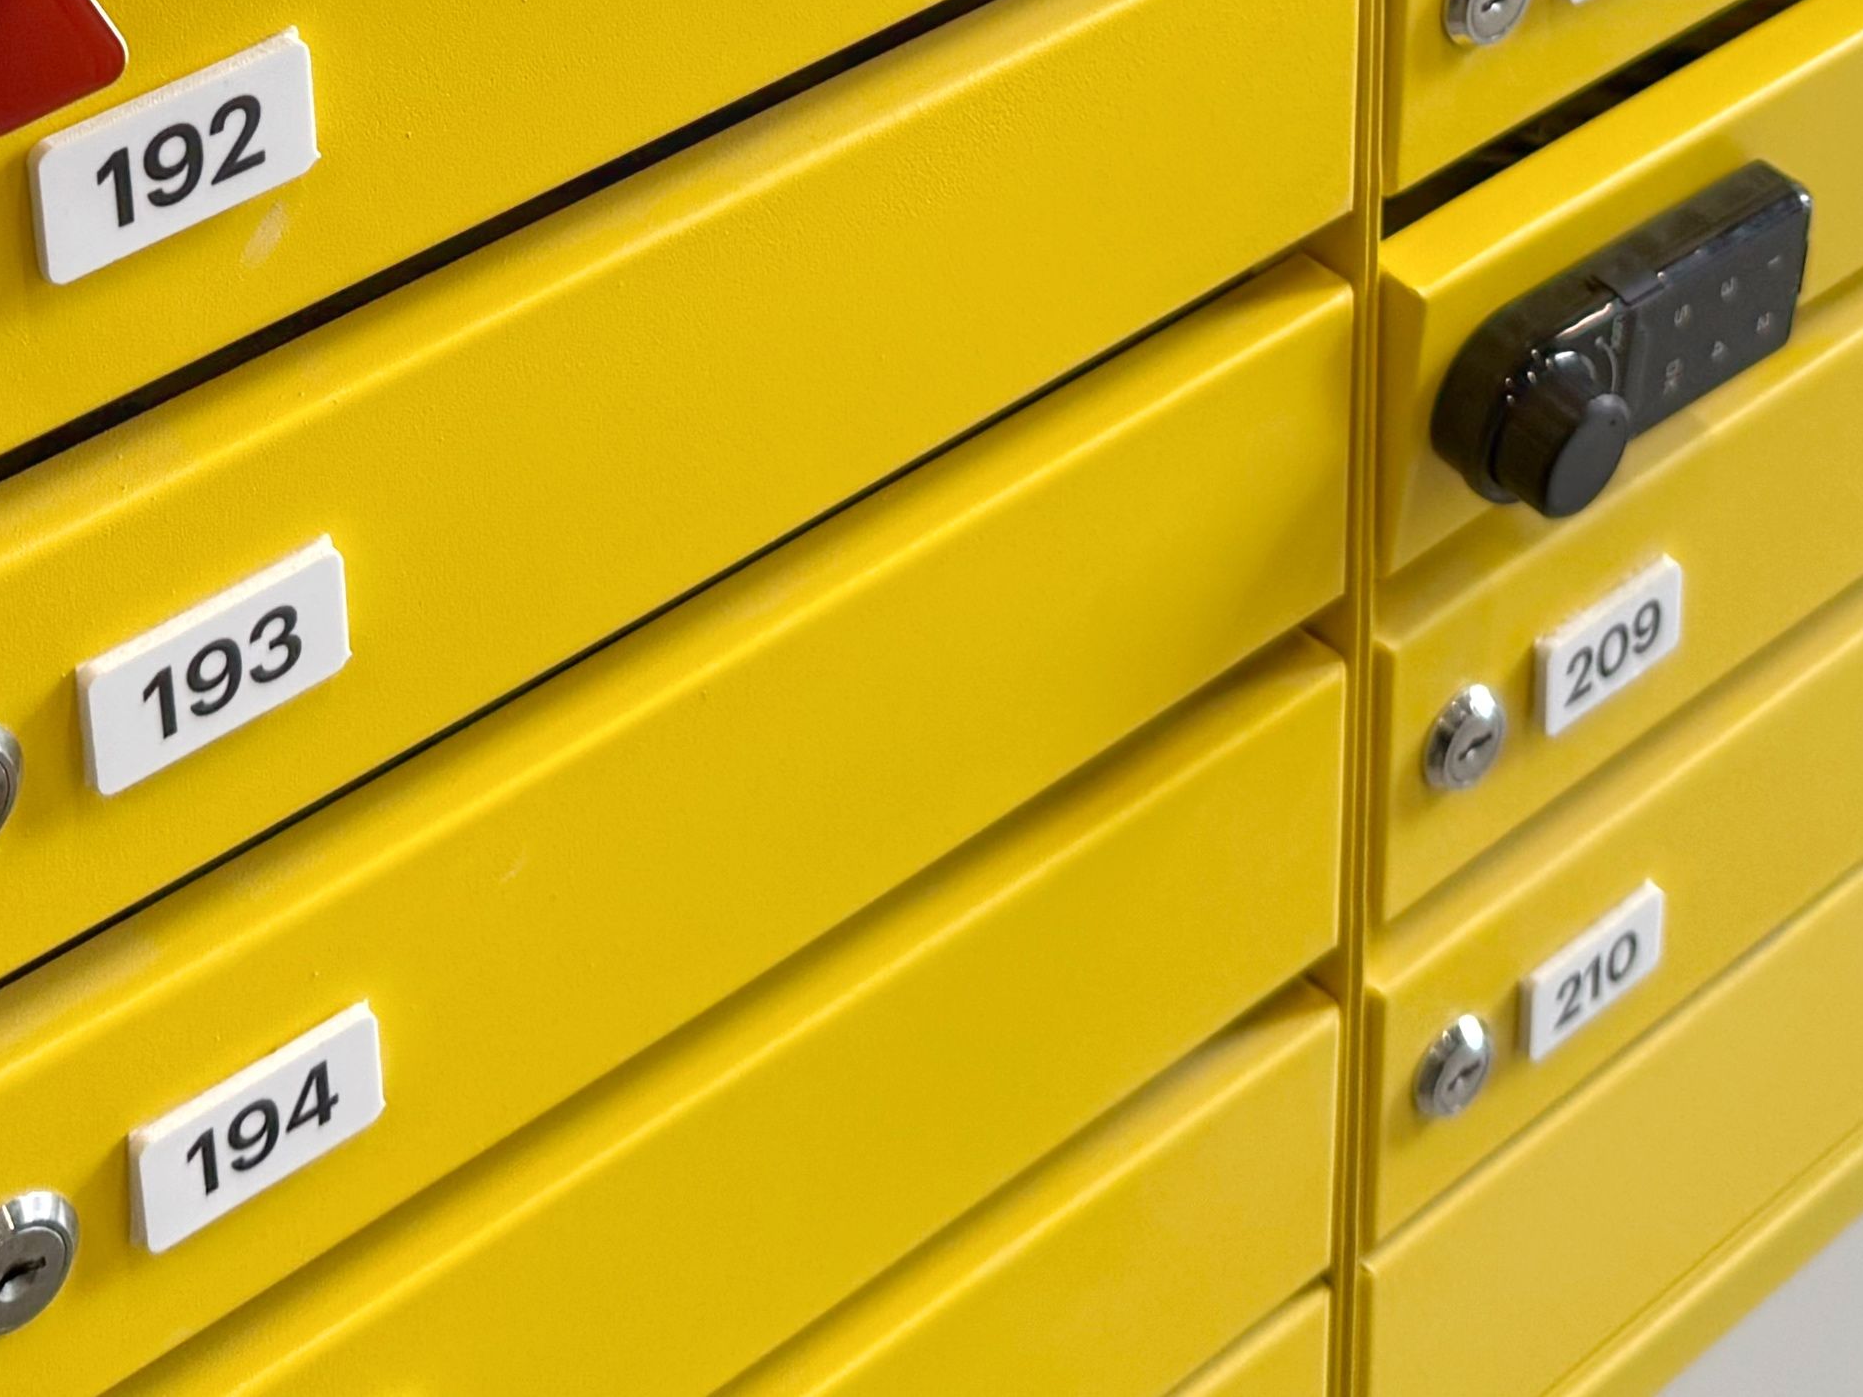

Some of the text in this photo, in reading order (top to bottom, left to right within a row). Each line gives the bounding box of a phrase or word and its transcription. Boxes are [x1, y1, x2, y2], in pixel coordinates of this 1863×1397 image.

[97, 95, 265, 227] 192
[143, 606, 301, 739] 193
[1565, 600, 1662, 706] 209
[1555, 931, 1638, 1029] 210
[187, 1061, 338, 1196] 194
